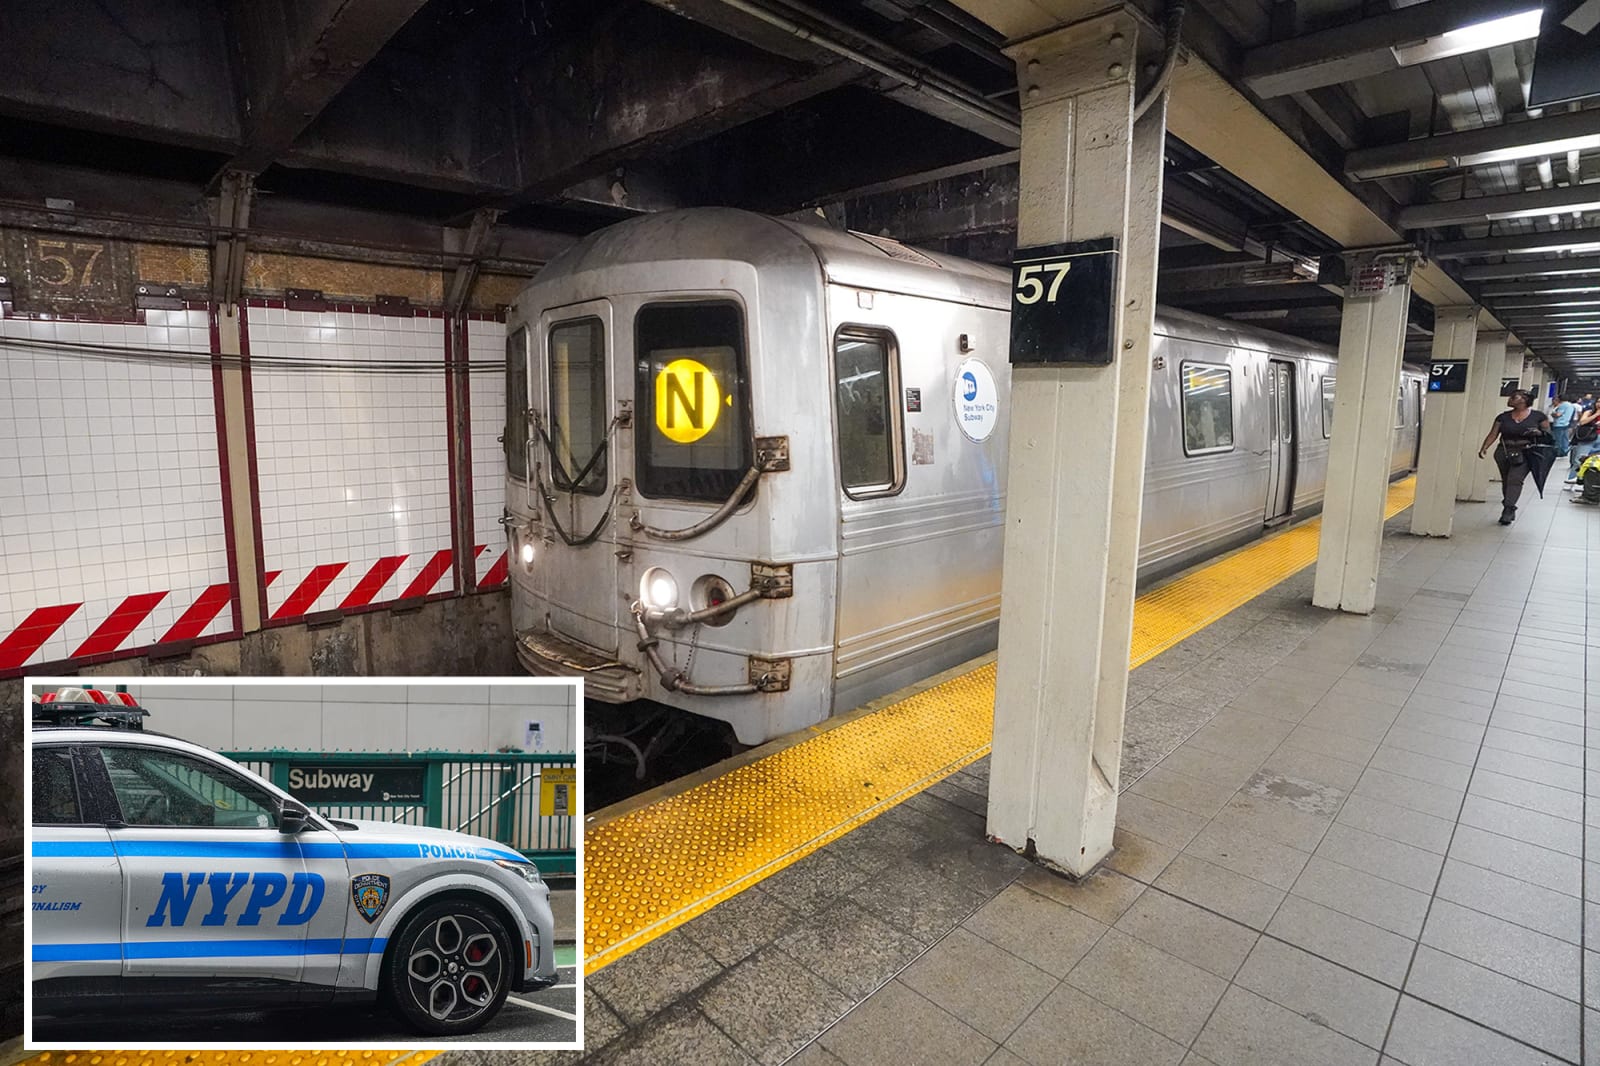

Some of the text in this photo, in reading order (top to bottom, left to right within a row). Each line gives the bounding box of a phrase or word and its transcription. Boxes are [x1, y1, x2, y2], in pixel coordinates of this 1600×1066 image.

[38, 239, 104, 287] 57
[1016, 262, 1071, 304] 57
[1432, 364, 1454, 376] 57
[666, 371, 704, 429] N
[986, 403, 995, 412] City
[964, 413, 983, 422] Subway
[288, 768, 374, 792] Subway
[420, 843, 475, 859] POLICE
[145, 872, 326, 927] NYPD
